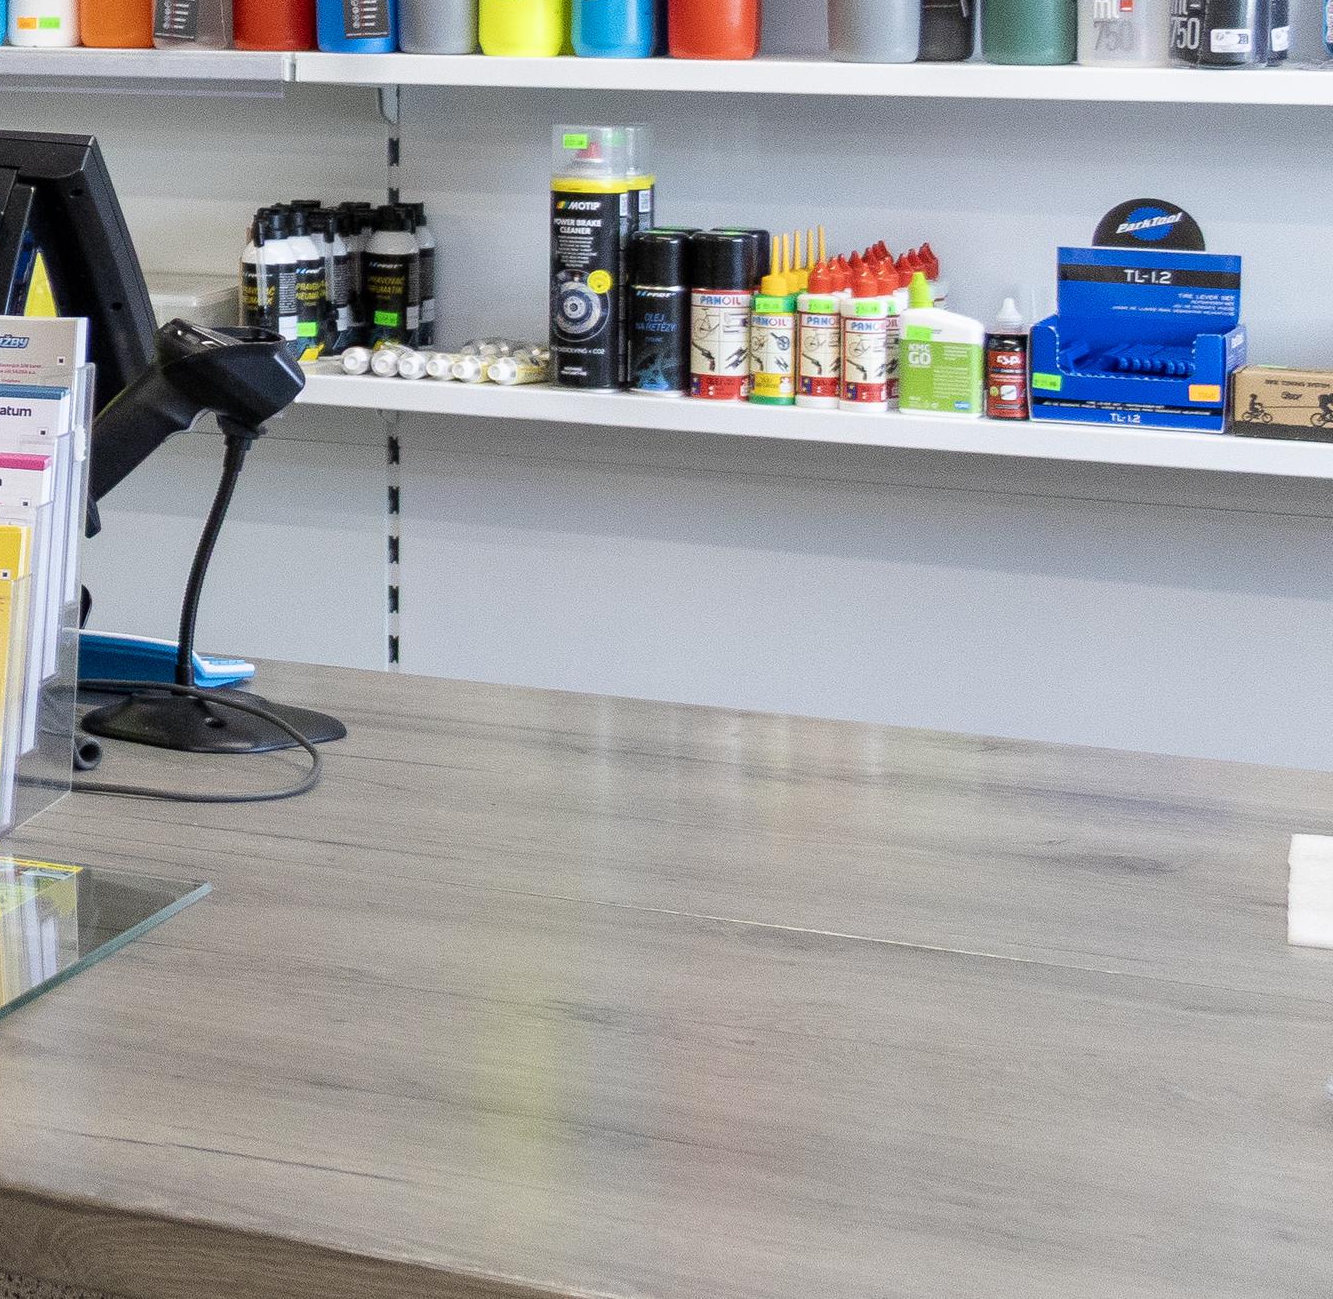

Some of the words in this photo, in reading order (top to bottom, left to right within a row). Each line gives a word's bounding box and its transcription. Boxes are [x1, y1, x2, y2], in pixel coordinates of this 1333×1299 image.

[1171, 17, 1199, 50] 750
[568, 201, 601, 210] MOTIP
[576, 218, 602, 227] BRAKE
[1115, 211, 1183, 234] ParkTool
[559, 226, 591, 235] CLEANER
[1124, 268, 1172, 284] TL-1.2
[700, 295, 741, 305] PANOIL
[752, 317, 787, 326] PANOIL
[908, 351, 932, 366] GO
[1109, 412, 1141, 423] TL-1.2
